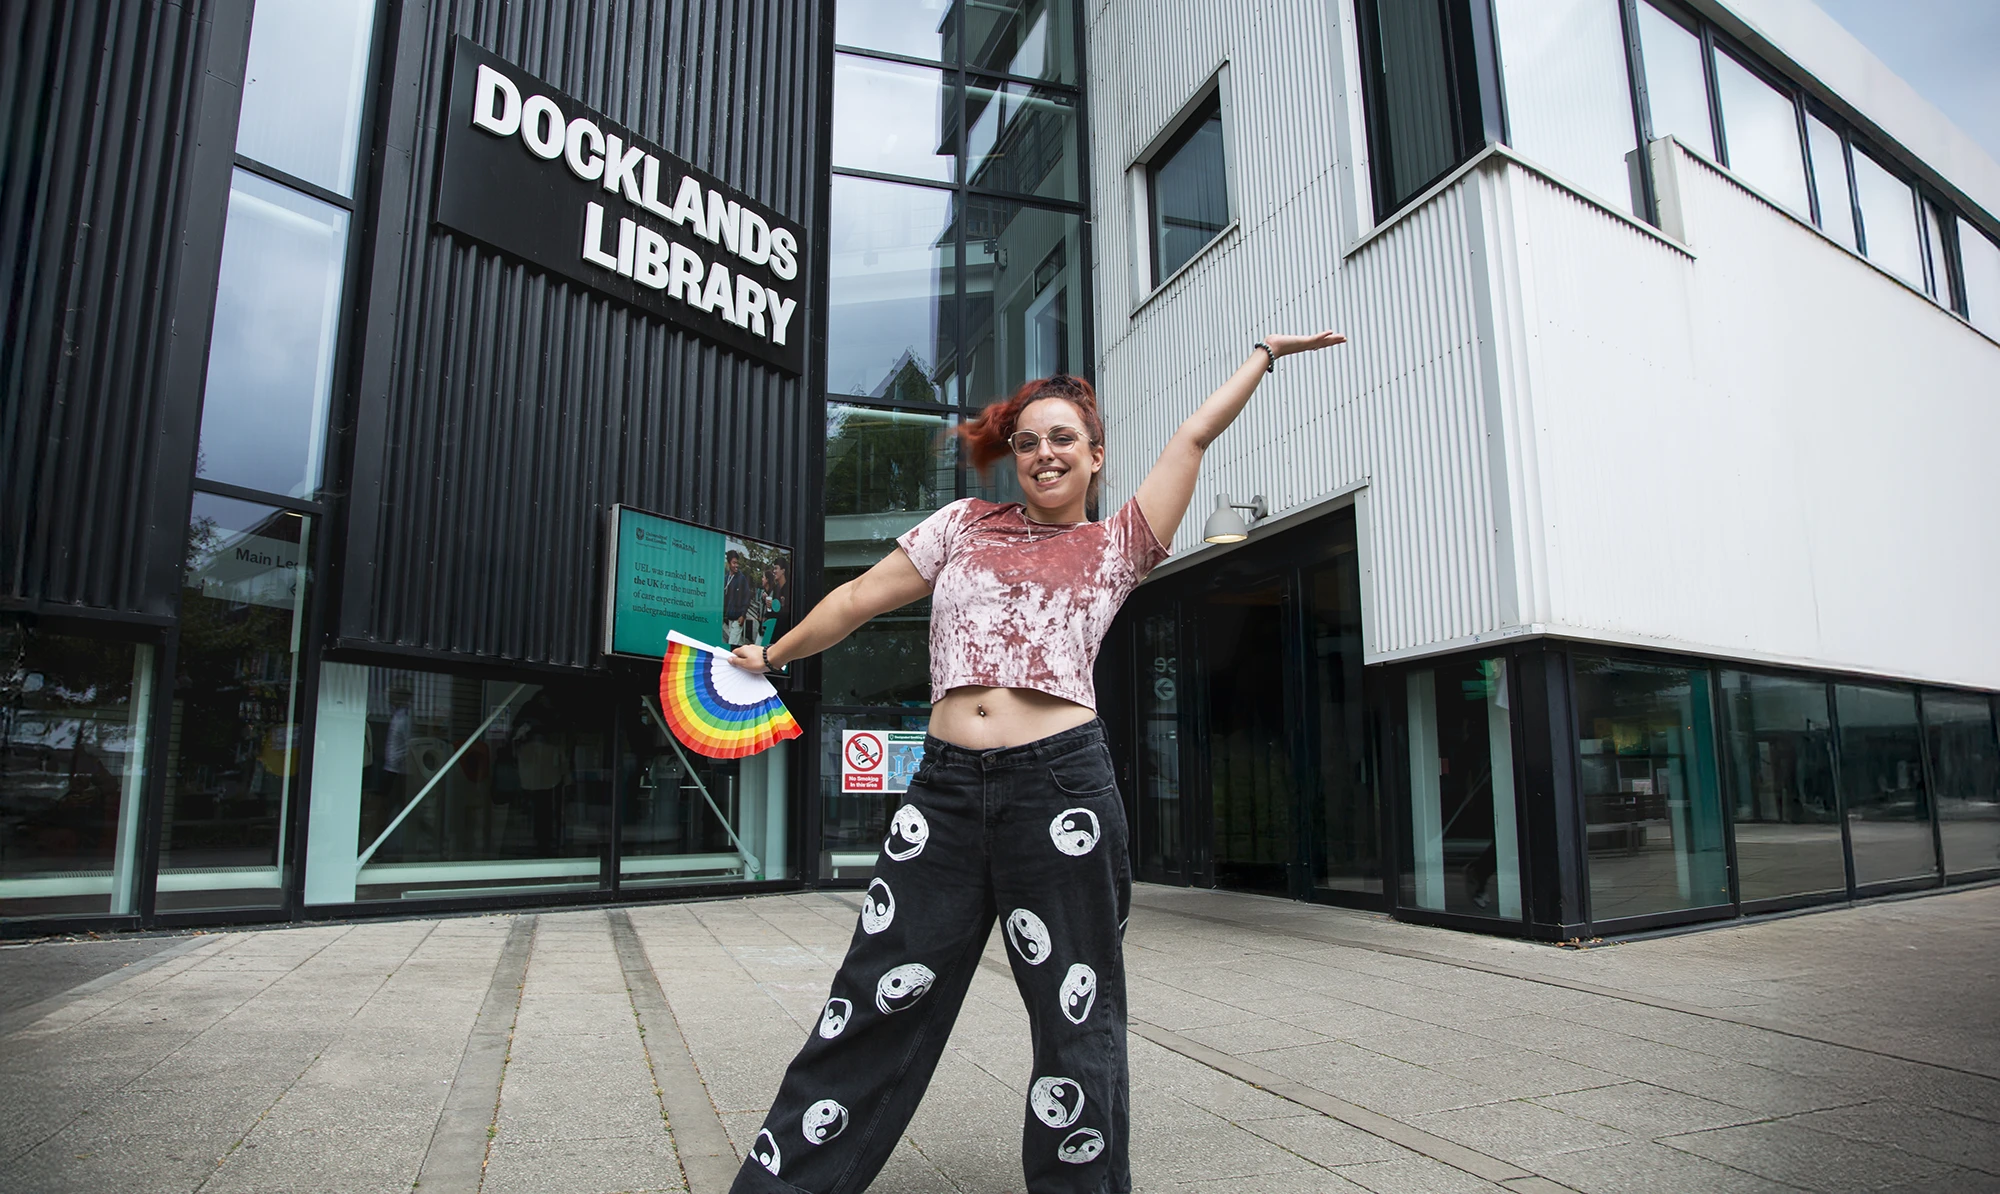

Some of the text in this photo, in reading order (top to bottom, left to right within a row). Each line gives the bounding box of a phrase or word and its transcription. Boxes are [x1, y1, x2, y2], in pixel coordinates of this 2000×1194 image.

[473, 63, 798, 280] DOCKLANDS
[583, 201, 797, 346] LIBRARY
[236, 548, 271, 566] Main
[635, 562, 705, 584] UEL was ranked 1st in
[634, 575, 707, 598] the UK for the number
[633, 589, 694, 608] of care experienced
[633, 604, 709, 623] undergraduate students.
